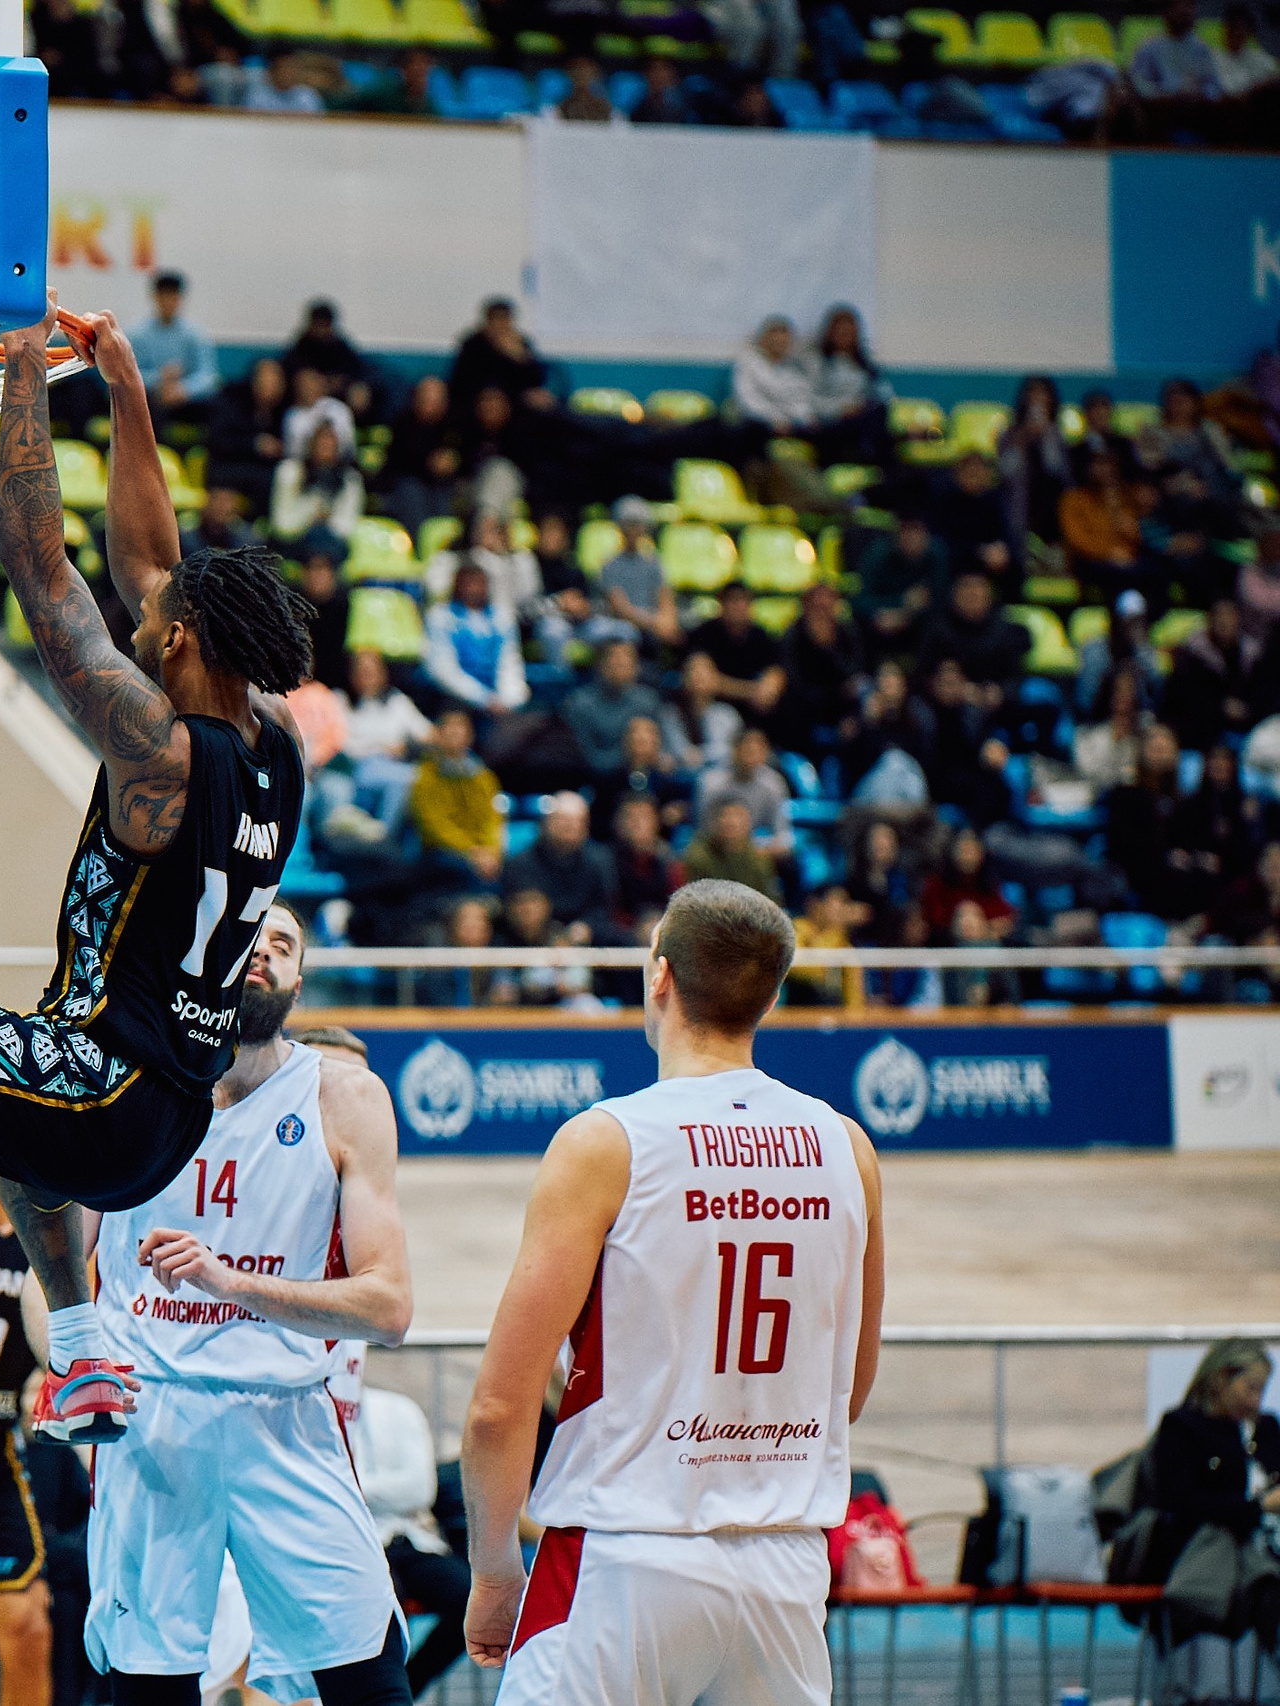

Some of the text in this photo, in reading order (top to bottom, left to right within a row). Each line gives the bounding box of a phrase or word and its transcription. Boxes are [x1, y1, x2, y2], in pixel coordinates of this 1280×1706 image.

[180, 867, 281, 988] 17
[679, 1124, 823, 1168] TRUSHKIN
[195, 1159, 238, 1218] 14
[685, 1188, 830, 1222] BetBoom
[714, 1241, 794, 1375] 16
[756, 1453, 808, 1463] компания
